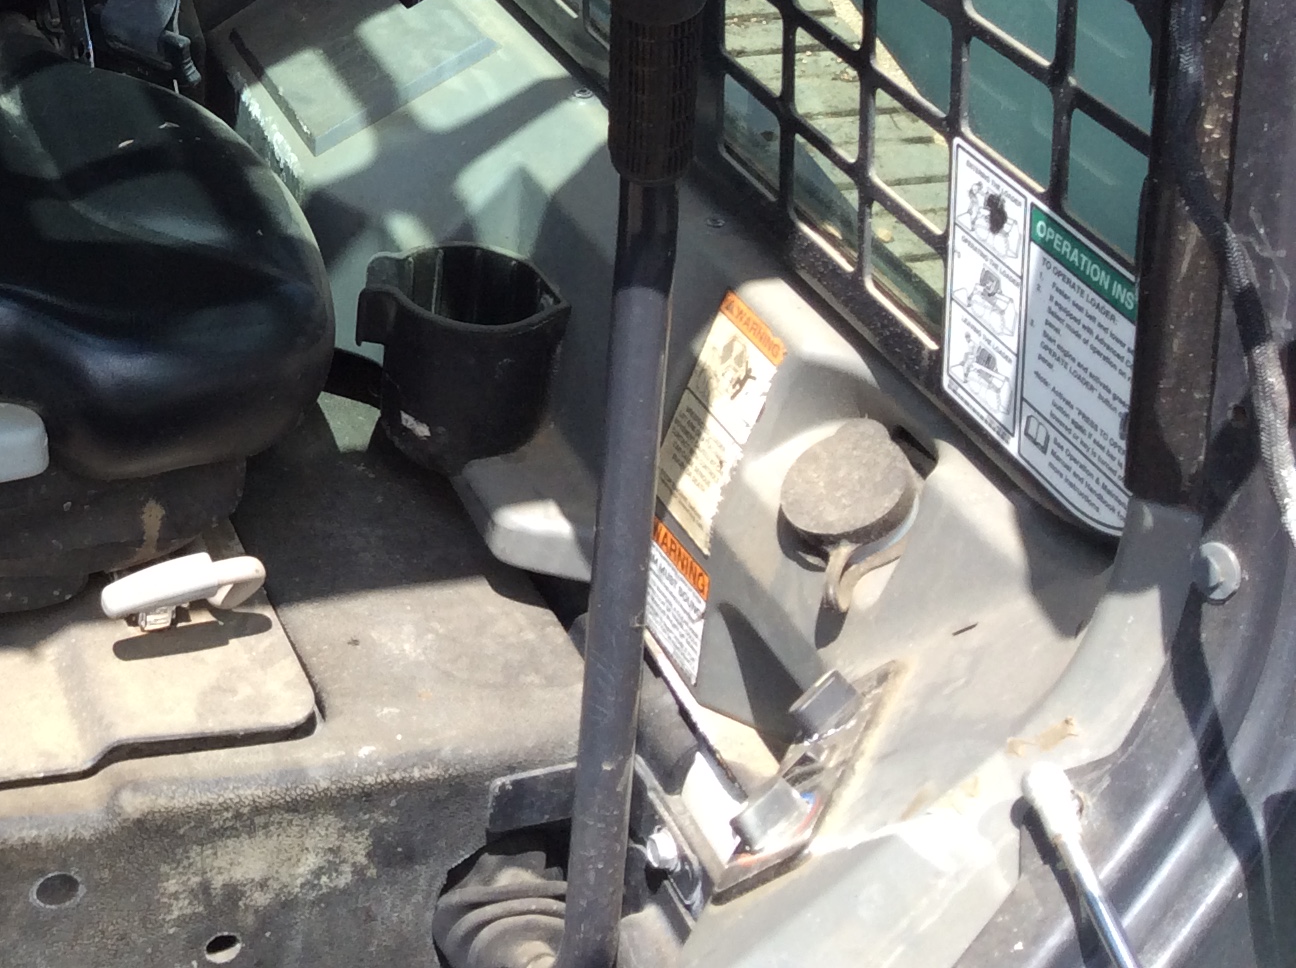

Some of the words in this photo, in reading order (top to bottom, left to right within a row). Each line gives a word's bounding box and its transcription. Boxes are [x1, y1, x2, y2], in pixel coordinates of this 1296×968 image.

[1036, 221, 1110, 289] OPERATION
[1042, 258, 1052, 270] TO
[1052, 266, 1085, 297] OPERATE
[735, 307, 781, 358] WARNING
